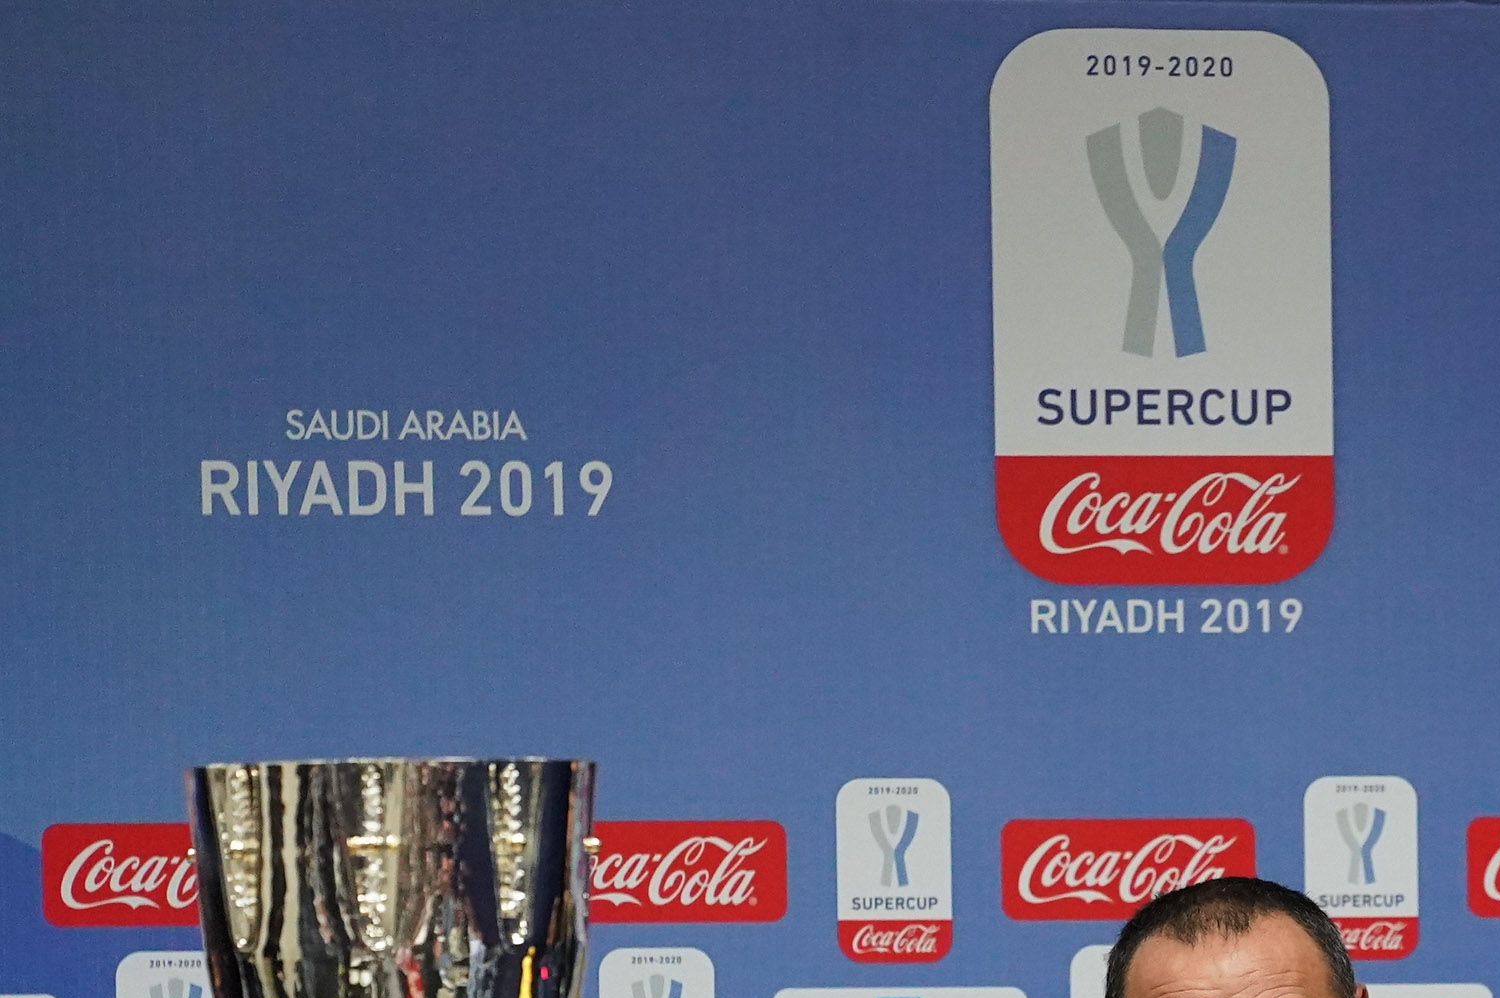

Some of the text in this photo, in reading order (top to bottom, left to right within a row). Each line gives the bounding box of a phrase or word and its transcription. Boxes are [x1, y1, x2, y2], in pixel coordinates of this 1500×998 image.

[1086, 55, 1232, 77] 2019-2020
[1037, 389, 1291, 426] SUPERCUP
[285, 409, 527, 440] SAUDI ARABIA
[200, 460, 612, 516] RIYADH 2019
[1030, 599, 1302, 633] RIYADH 2019
[851, 897, 938, 910] SUPERCUP
[1318, 892, 1408, 911] SUPERCUP
